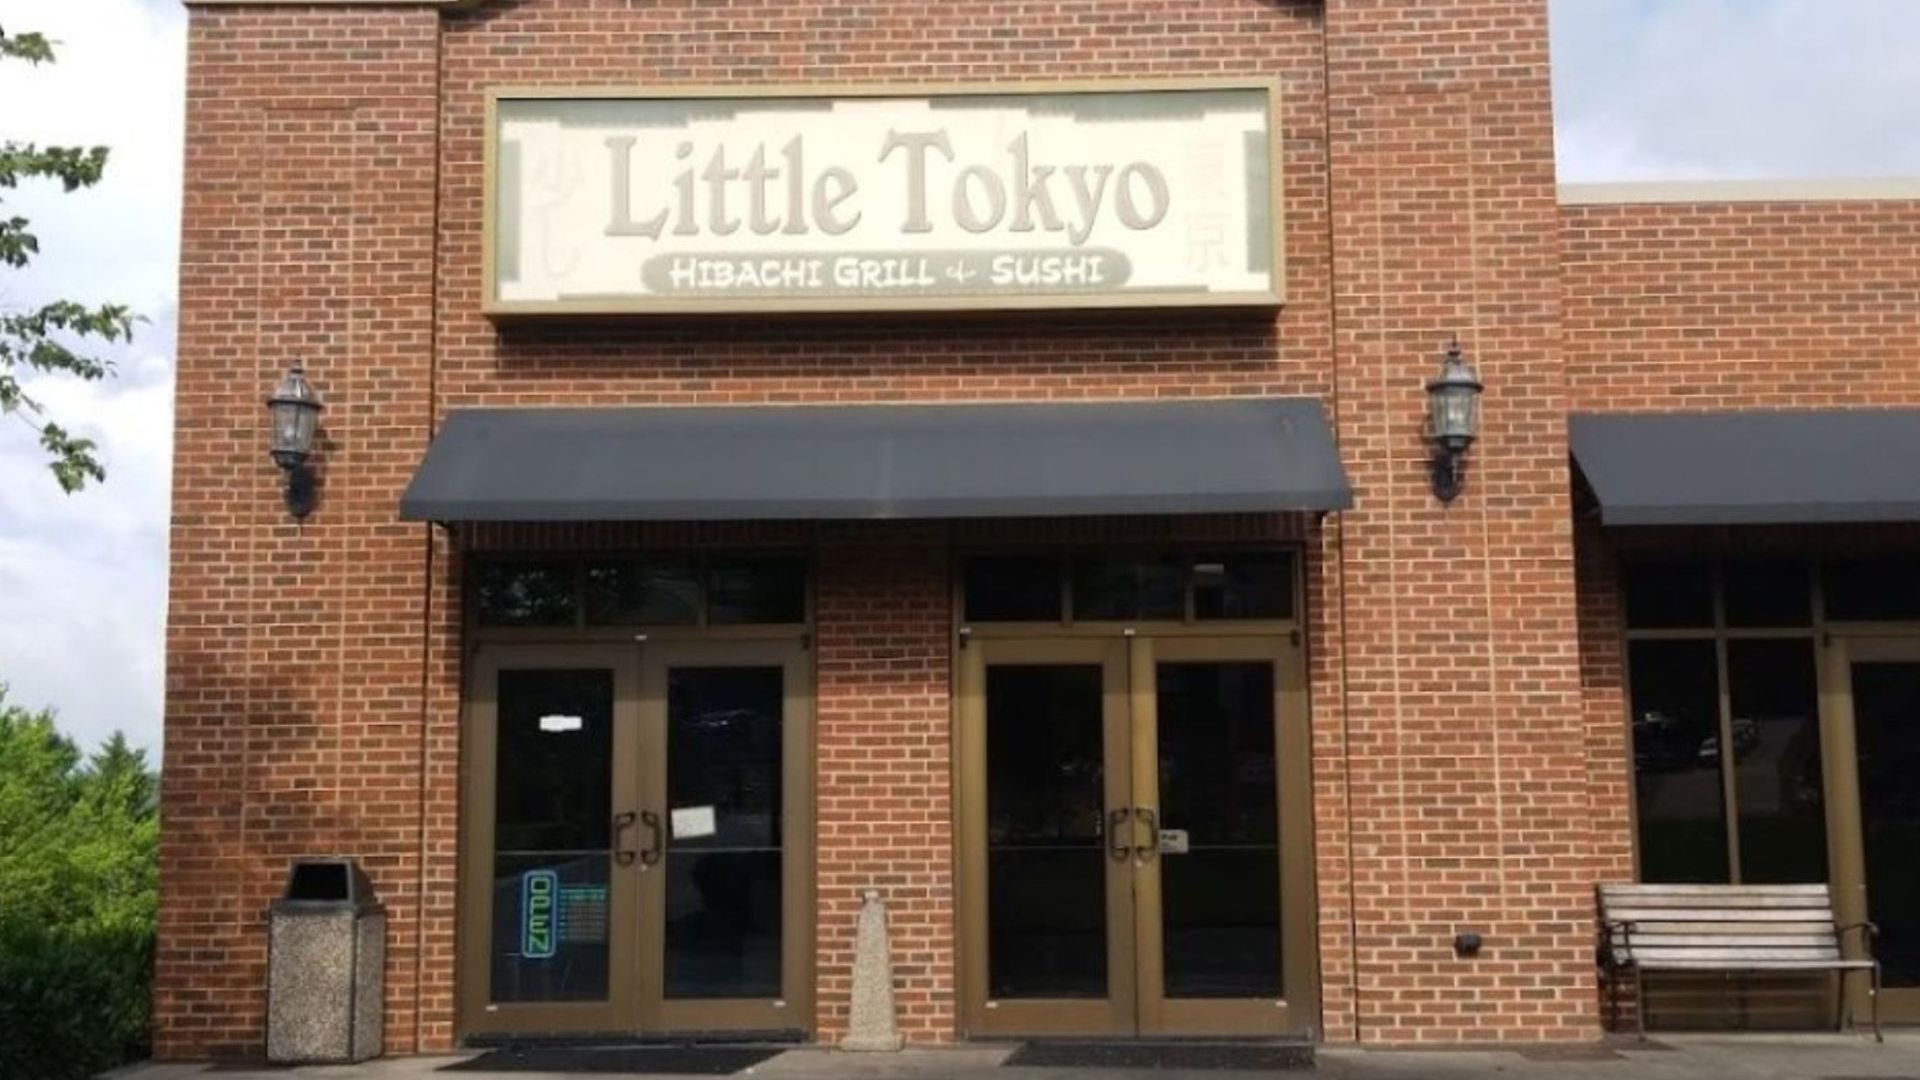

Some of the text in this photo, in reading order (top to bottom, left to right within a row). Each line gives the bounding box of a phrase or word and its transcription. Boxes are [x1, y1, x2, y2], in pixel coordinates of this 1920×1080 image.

[605, 130, 1169, 245] Little Tokyo
[670, 258, 821, 288] HIBACHI
[834, 256, 934, 288] GRILL
[991, 255, 1104, 284] SUSHI
[530, 877, 550, 952] OPEN
